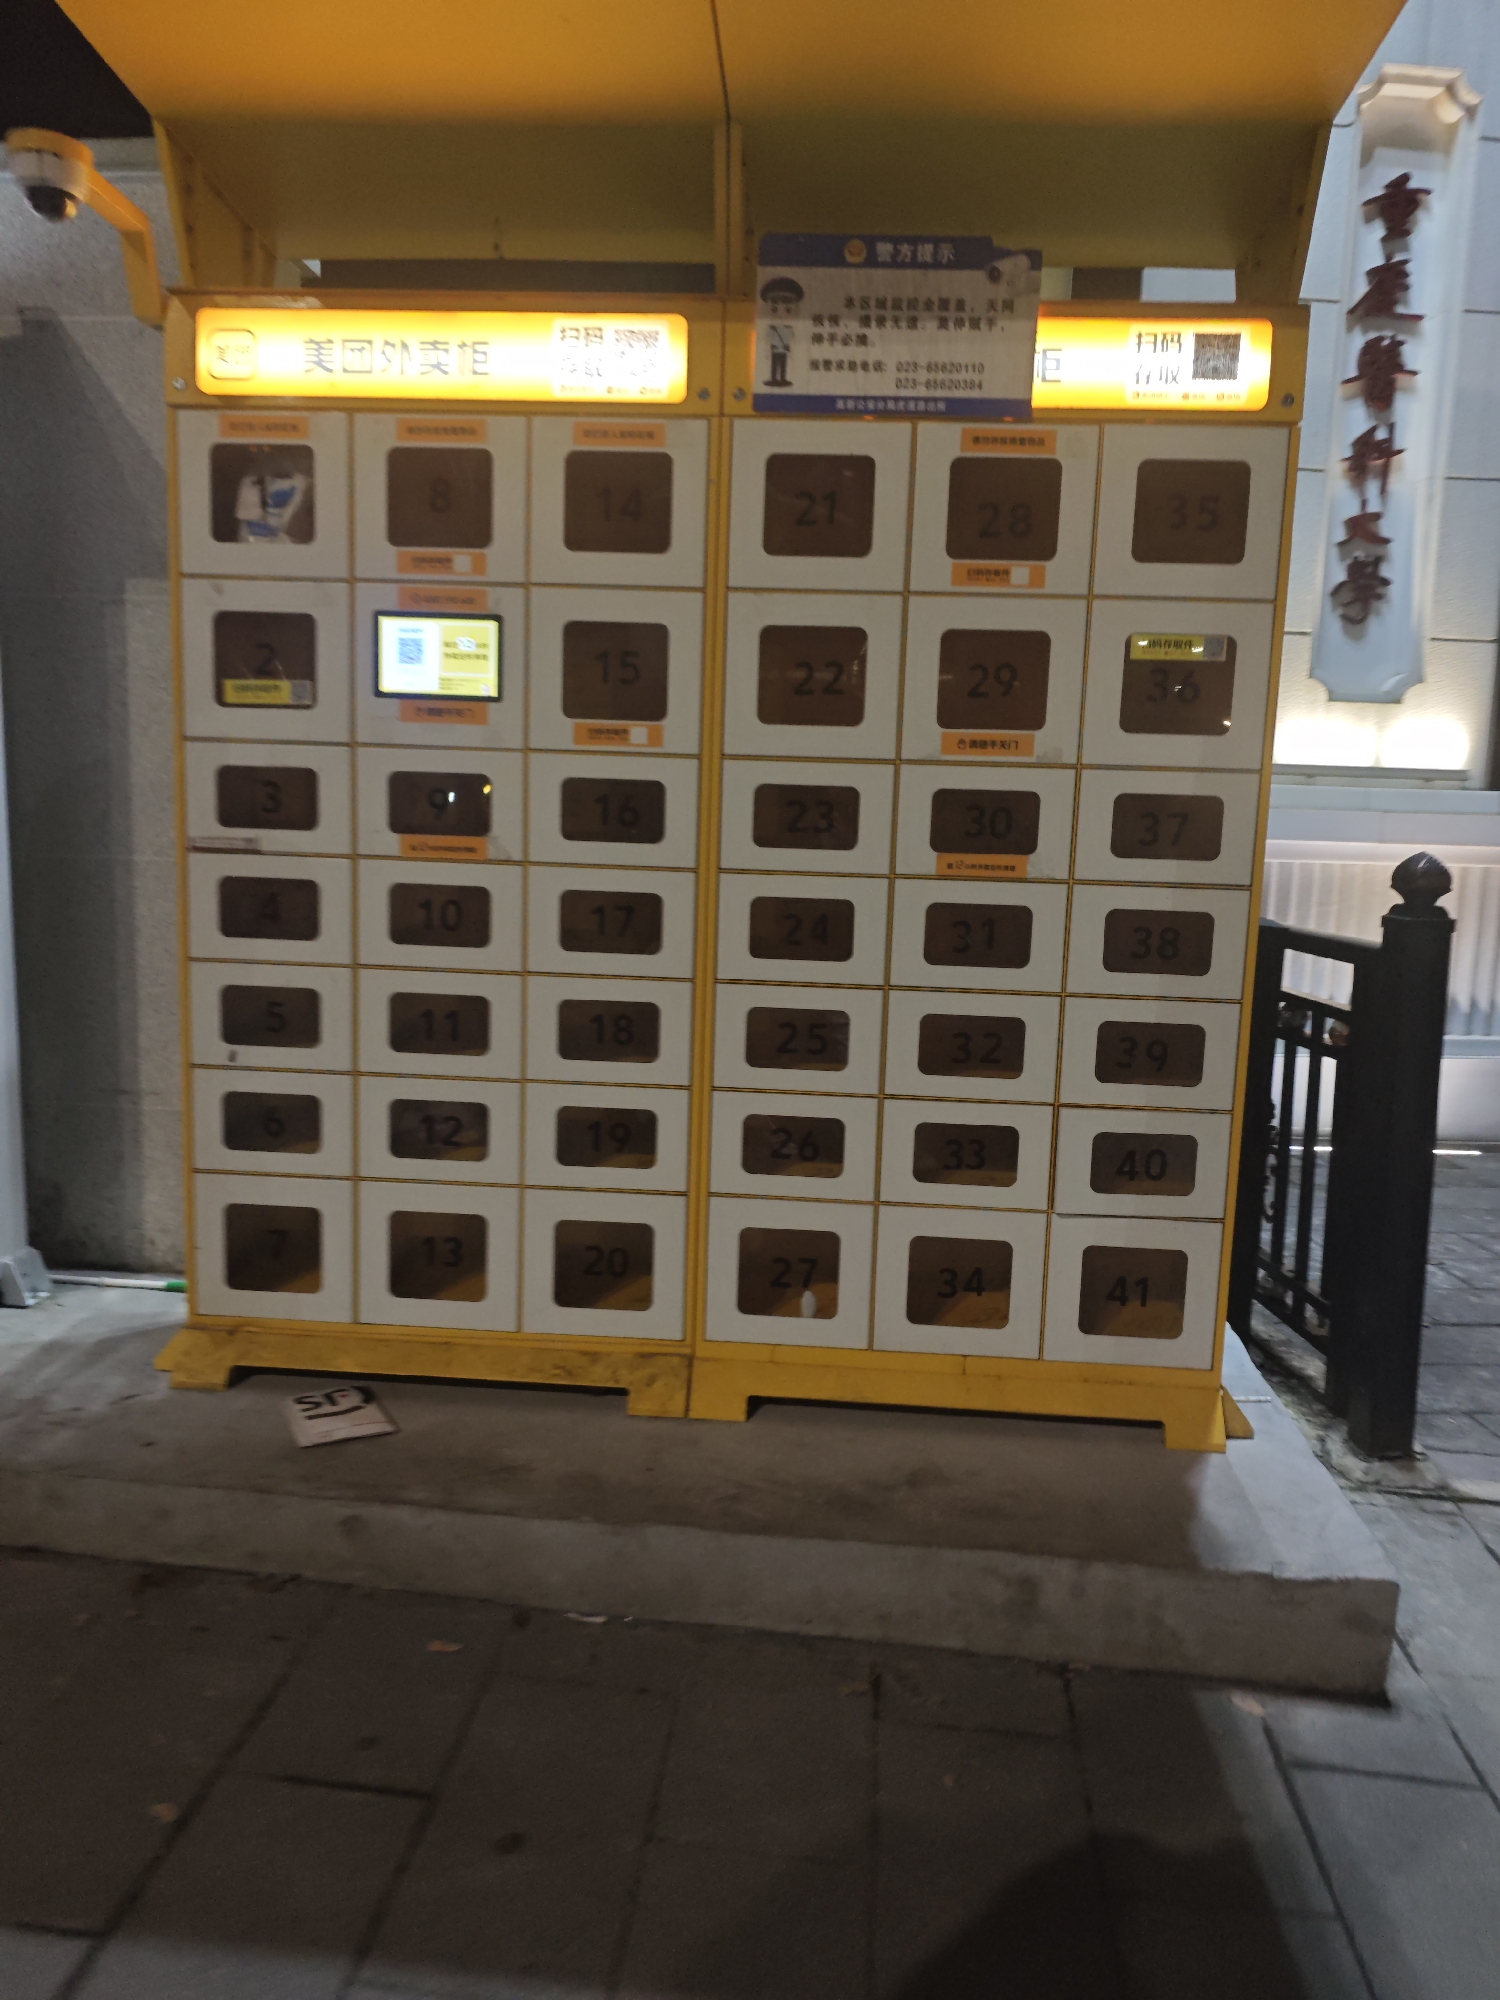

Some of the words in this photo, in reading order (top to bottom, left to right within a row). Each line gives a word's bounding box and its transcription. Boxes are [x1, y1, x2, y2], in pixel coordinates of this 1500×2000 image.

[876, 241, 956, 265] 警方提示
[303, 337, 490, 376] 美团外卖柜
[1135, 331, 1183, 354] 扫码
[429, 479, 450, 513] 8
[596, 487, 643, 523] 14
[795, 491, 837, 526] 21
[979, 503, 1032, 538] 28
[1168, 494, 1220, 532] 35
[255, 643, 277, 676] 2
[595, 650, 641, 684] 15
[794, 661, 845, 696] 22
[968, 663, 1017, 698] 29
[1147, 668, 1201, 704] 36
[261, 781, 281, 814] 3
[427, 788, 447, 821] 9
[595, 794, 640, 828] 16
[786, 800, 835, 834] 23
[965, 806, 1012, 839] 30
[1138, 812, 1189, 847] 37
[260, 892, 279, 923] 4
[417, 899, 462, 931] 10
[590, 905, 634, 937] 17
[784, 914, 828, 946] 24
[952, 919, 996, 952] 31
[1130, 926, 1180, 960] 38
[265, 1001, 286, 1033] 5
[419, 1009, 460, 1042] 11
[589, 1013, 633, 1045] 18
[777, 1022, 828, 1055] 25
[952, 1032, 1003, 1064] 32
[1116, 1038, 1168, 1072] 39
[263, 1106, 284, 1137] 6
[419, 1115, 463, 1146] 12
[586, 1121, 630, 1152] 19
[771, 1128, 819, 1160] 26
[944, 1139, 986, 1171] 33
[1116, 1149, 1166, 1181] 40
[266, 1228, 288, 1259] 7
[422, 1236, 463, 1267] 13
[583, 1245, 628, 1277] 20
[770, 1258, 818, 1289] 27
[938, 1267, 985, 1298] 34
[1107, 1276, 1148, 1308] 41
